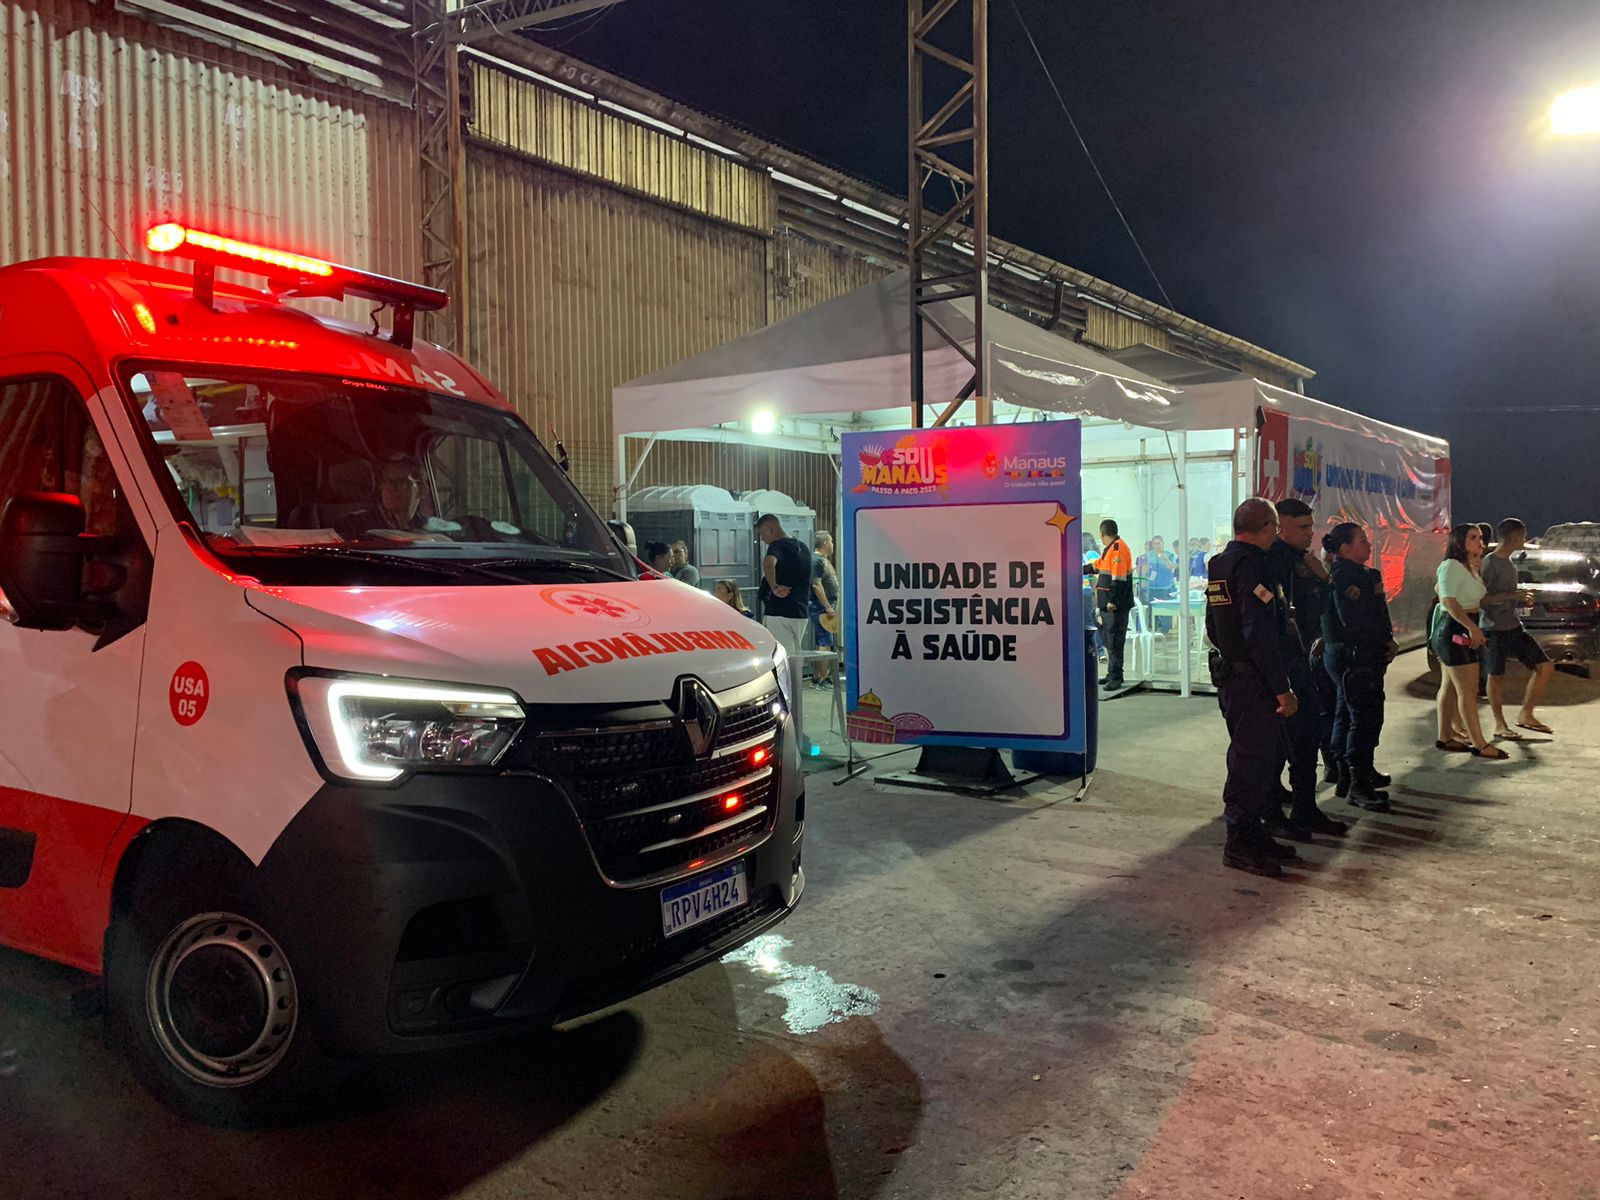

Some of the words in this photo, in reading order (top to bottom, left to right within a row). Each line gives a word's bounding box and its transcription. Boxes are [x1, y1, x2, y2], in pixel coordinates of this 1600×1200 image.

[342, 379, 365, 387] Grupo
[1003, 456, 1066, 470] Manaus
[863, 463, 948, 485] MANAUS
[871, 486, 893, 495] PASSO
[919, 485, 936, 494] 2023
[874, 562, 997, 589] UNIDADE
[1009, 561, 1045, 588] DE
[866, 593, 1055, 625] ASSISTÊNCIA
[923, 630, 1017, 661] SAÚDE
[174, 676, 204, 697] USA
[178, 699, 197, 718] 05
[671, 877, 739, 928] RPV4H24
